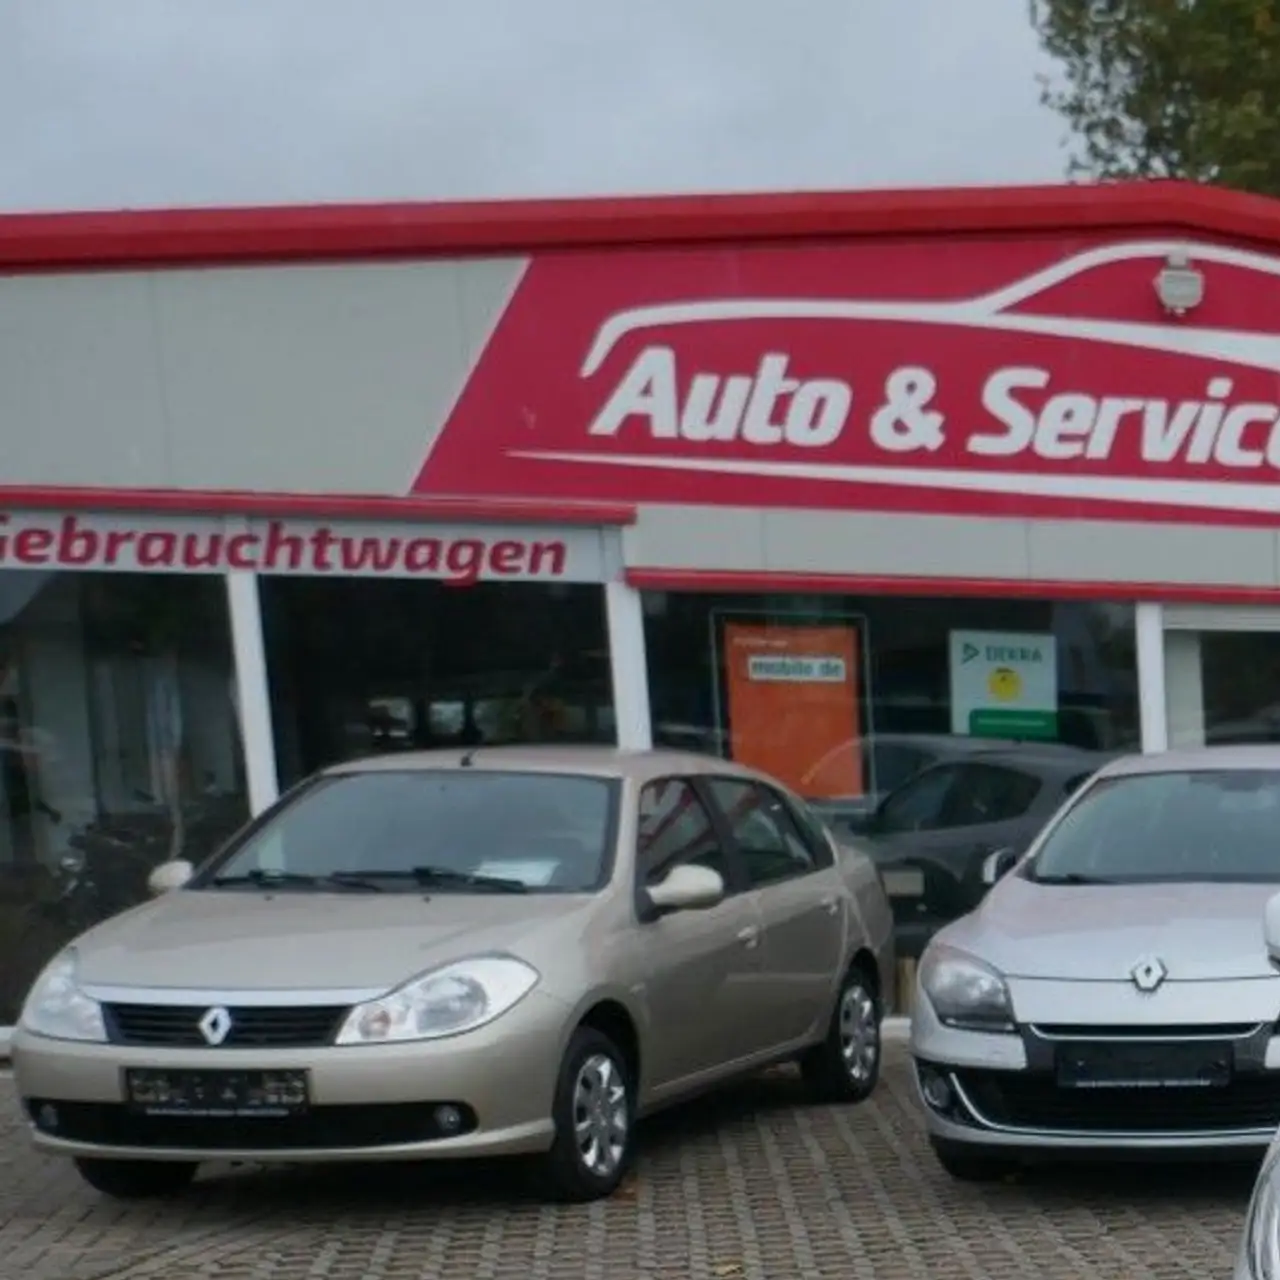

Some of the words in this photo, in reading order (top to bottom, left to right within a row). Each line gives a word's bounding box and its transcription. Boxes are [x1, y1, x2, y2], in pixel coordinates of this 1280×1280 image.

[588, 345, 852, 447] Auto
[869, 366, 945, 453] &
[0, 514, 567, 587] ebrauchtwagen
[751, 660, 842, 678] mobilede
